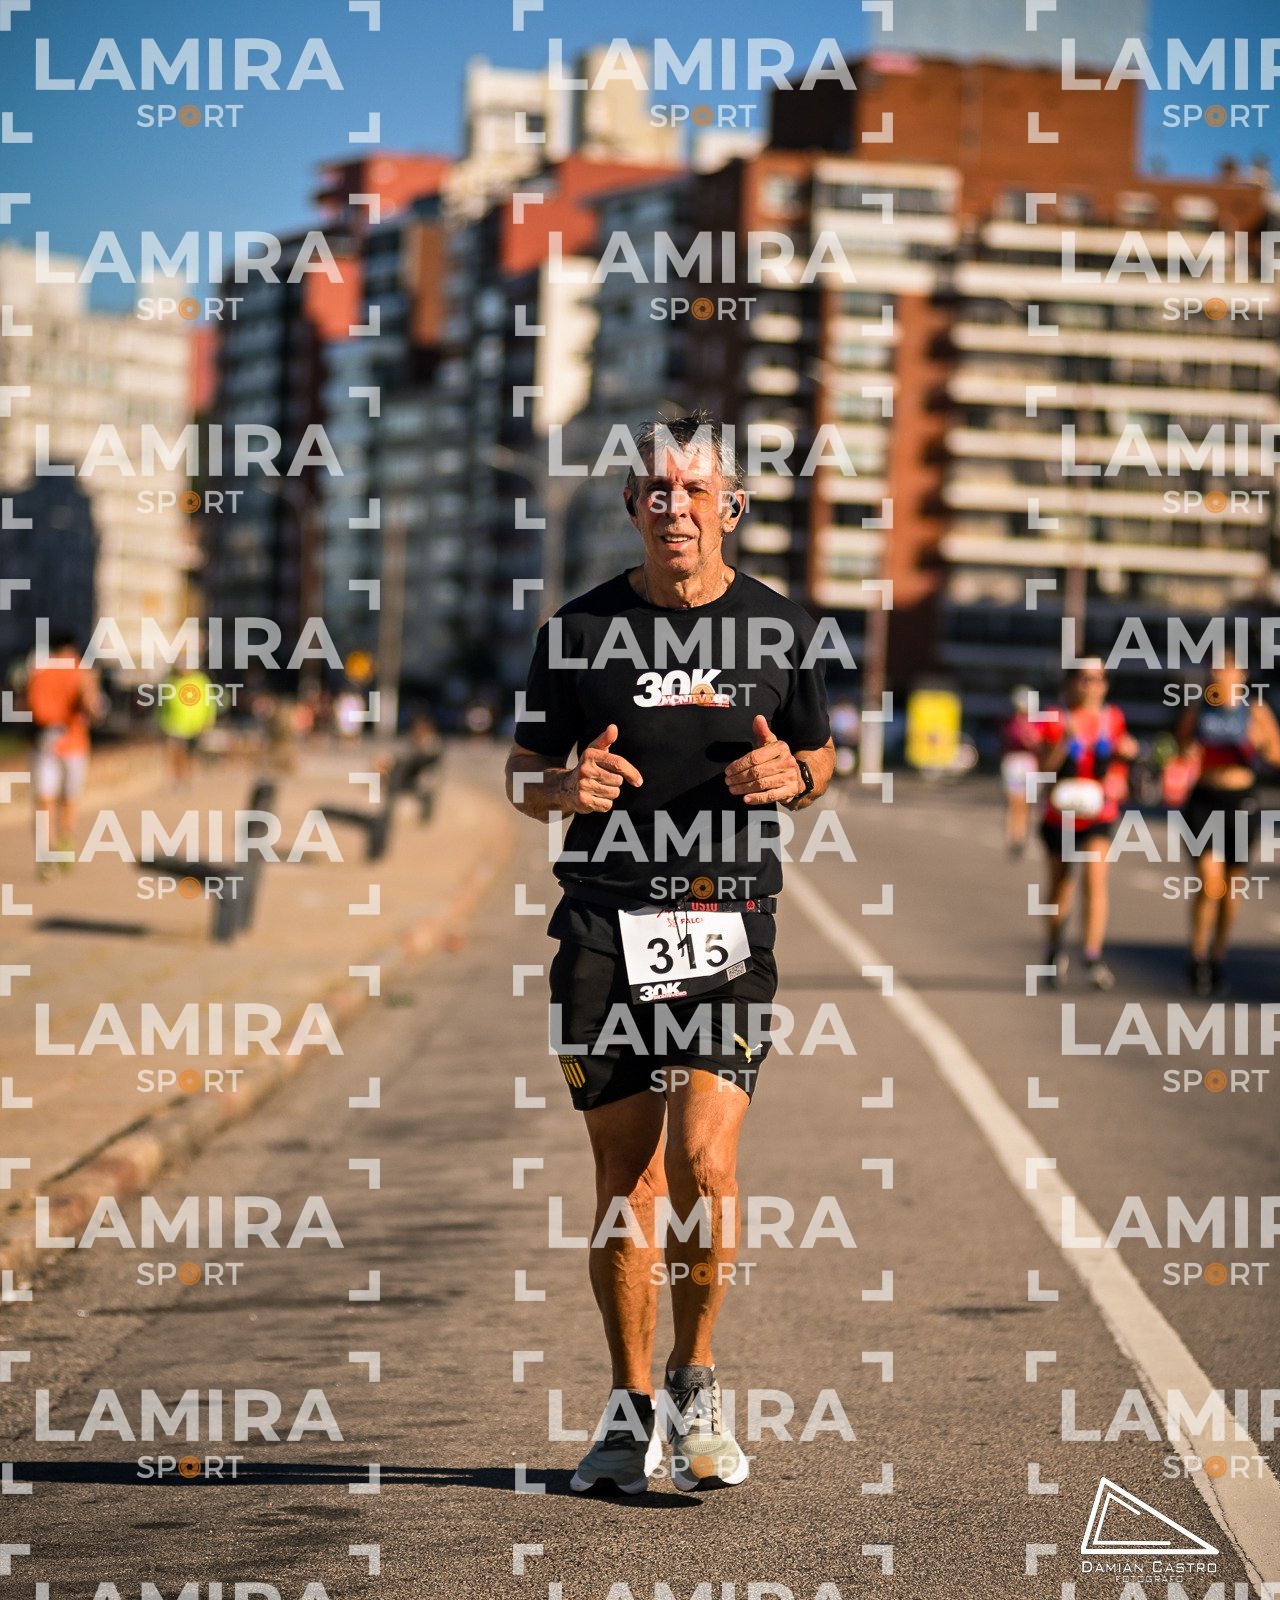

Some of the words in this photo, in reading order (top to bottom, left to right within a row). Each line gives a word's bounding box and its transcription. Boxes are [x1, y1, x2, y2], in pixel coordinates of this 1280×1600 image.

[633, 668, 721, 708] 30K
[647, 933, 729, 975] 315
[640, 981, 682, 1002] 30K
